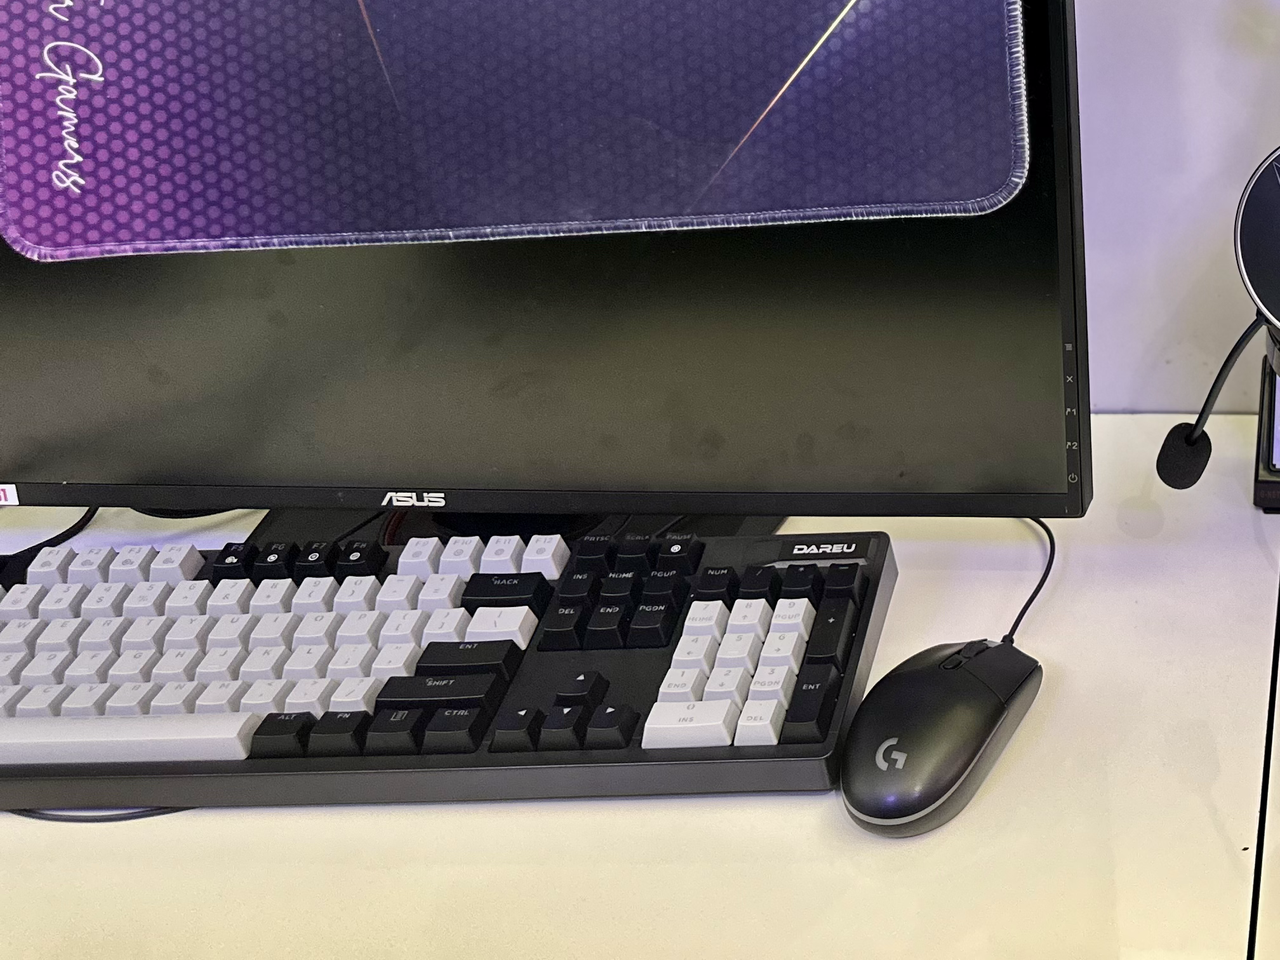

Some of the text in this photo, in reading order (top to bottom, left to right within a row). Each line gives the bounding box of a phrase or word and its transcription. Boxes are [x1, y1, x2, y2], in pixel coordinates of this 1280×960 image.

[0, 488, 8, 501] 1
[381, 492, 446, 507] ASUS
[793, 544, 856, 554] DAREU
